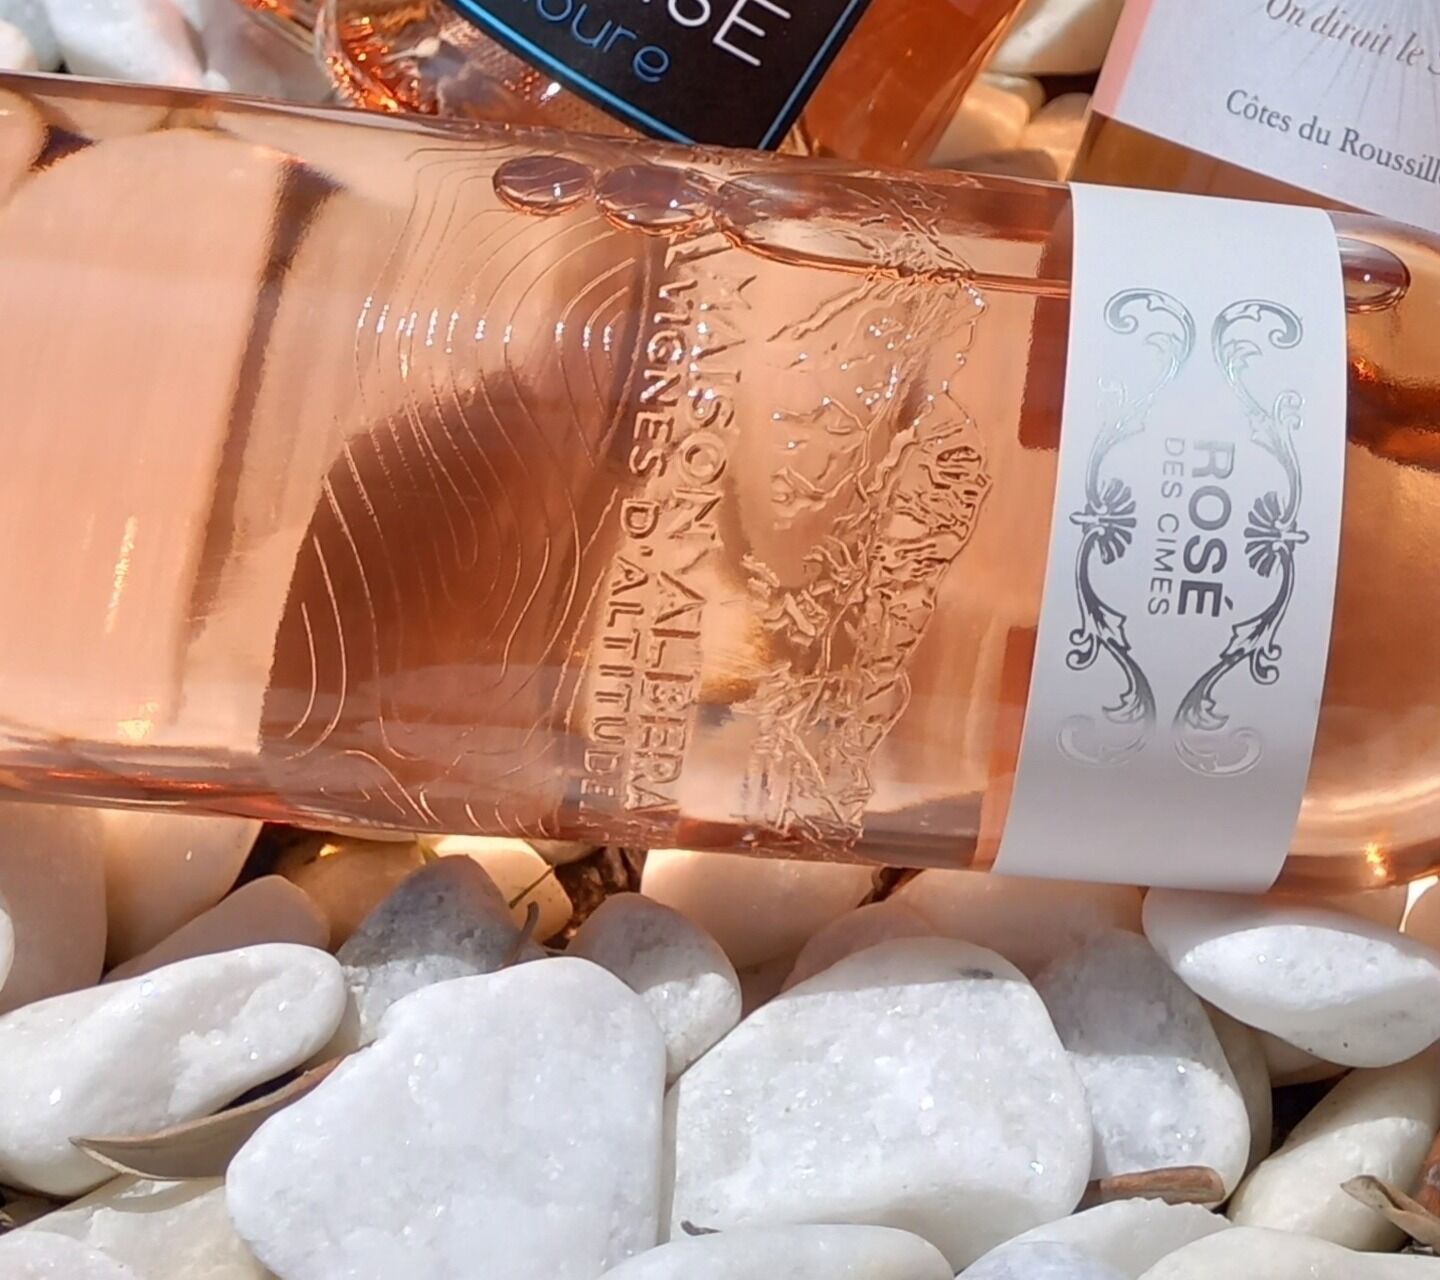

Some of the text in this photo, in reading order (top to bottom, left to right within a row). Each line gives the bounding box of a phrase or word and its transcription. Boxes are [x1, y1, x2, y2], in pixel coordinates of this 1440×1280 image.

[1224, 87, 1292, 134] Côtes
[1297, 113, 1333, 147] du
[1309, 4, 1394, 58] dirait
[1396, 38, 1425, 69] le
[580, 276, 699, 802] VIGNES D'ALTITUDE
[1147, 435, 1187, 618] DES CIMES
[1175, 439, 1236, 620] ROSÉ
